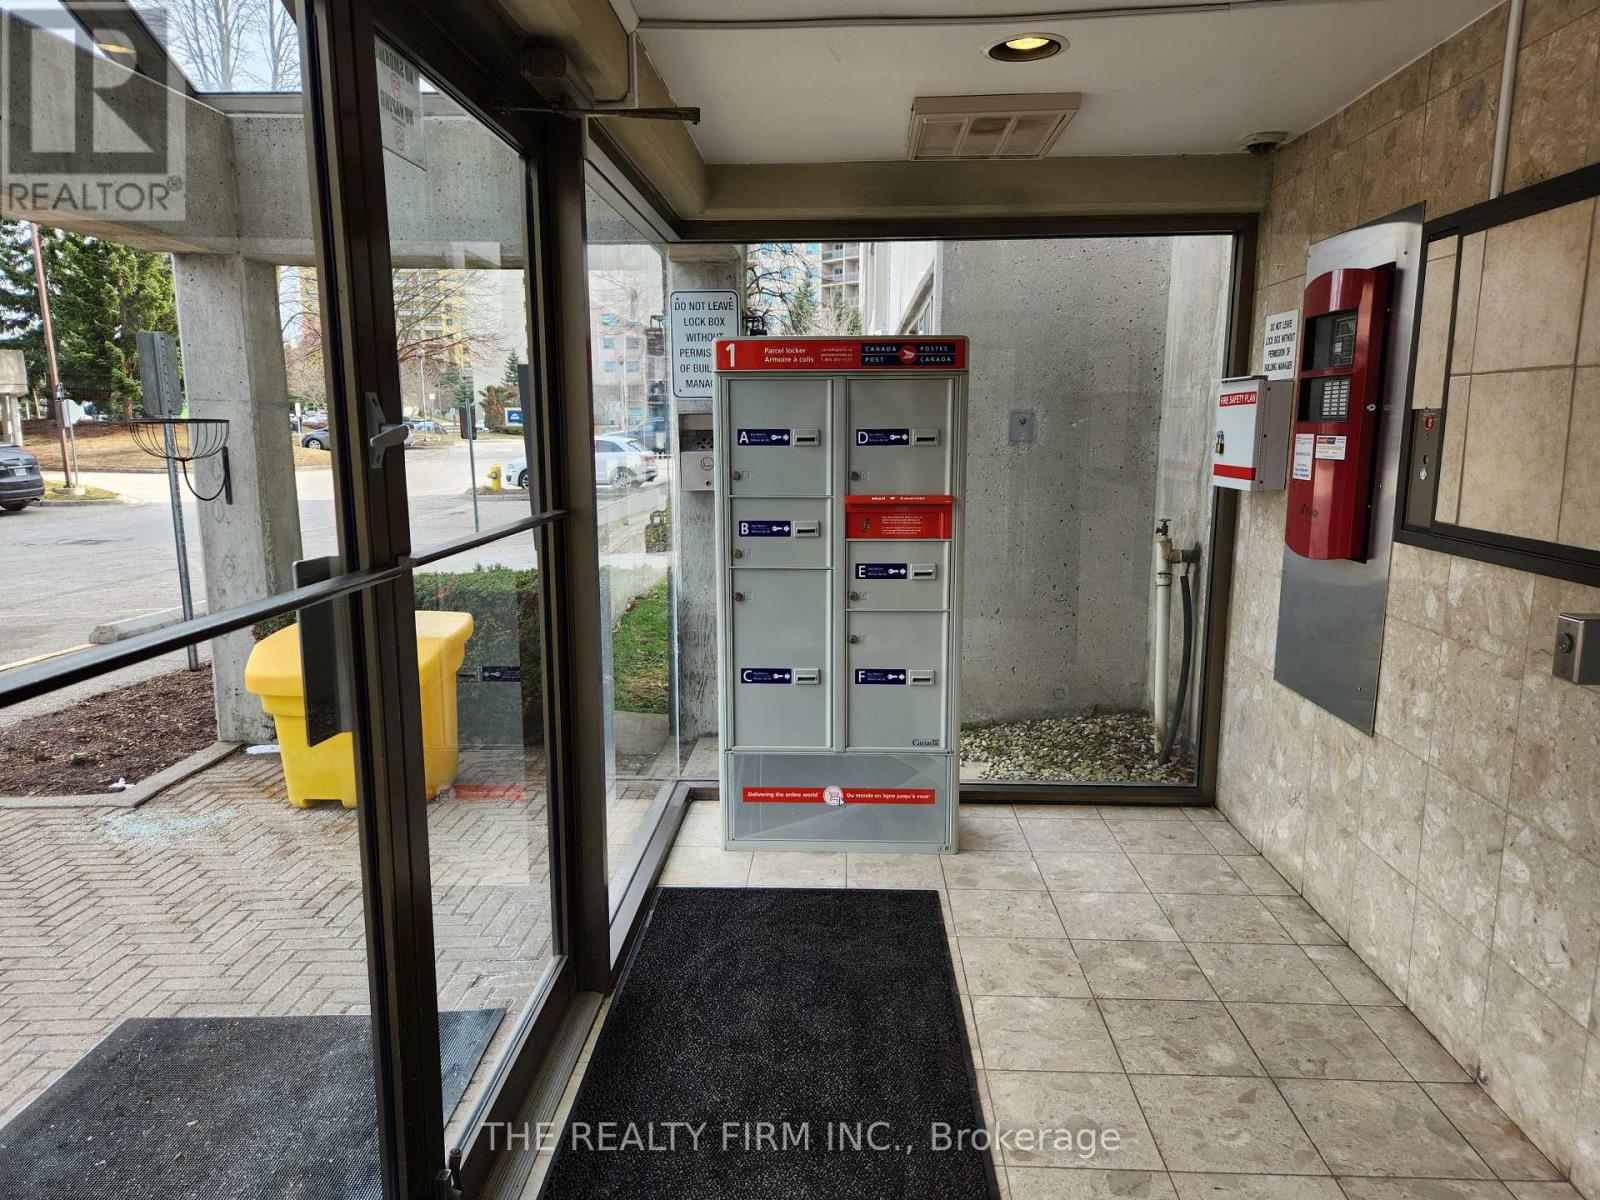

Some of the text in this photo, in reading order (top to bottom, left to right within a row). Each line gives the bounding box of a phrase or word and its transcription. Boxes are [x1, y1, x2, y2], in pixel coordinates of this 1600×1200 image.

[675, 301, 734, 311] DO NOT LEAVE
[683, 318, 725, 327] LOCK BOX
[1282, 319, 1293, 329] LEAVE
[680, 348, 712, 358] PERMIS
[725, 342, 736, 368] 1
[799, 355, 814, 363] colis
[680, 364, 713, 373] OF BUIL
[685, 379, 713, 389] MANA
[1220, 393, 1256, 405] FIRE SAFETY PLAN
[739, 431, 750, 444] A
[858, 431, 868, 444] D
[741, 522, 749, 535] B
[858, 565, 866, 578] E
[743, 670, 753, 682] C
[858, 670, 866, 683] F
[912, 738, 939, 747] Canada
[747, 791, 775, 799] Delivering
